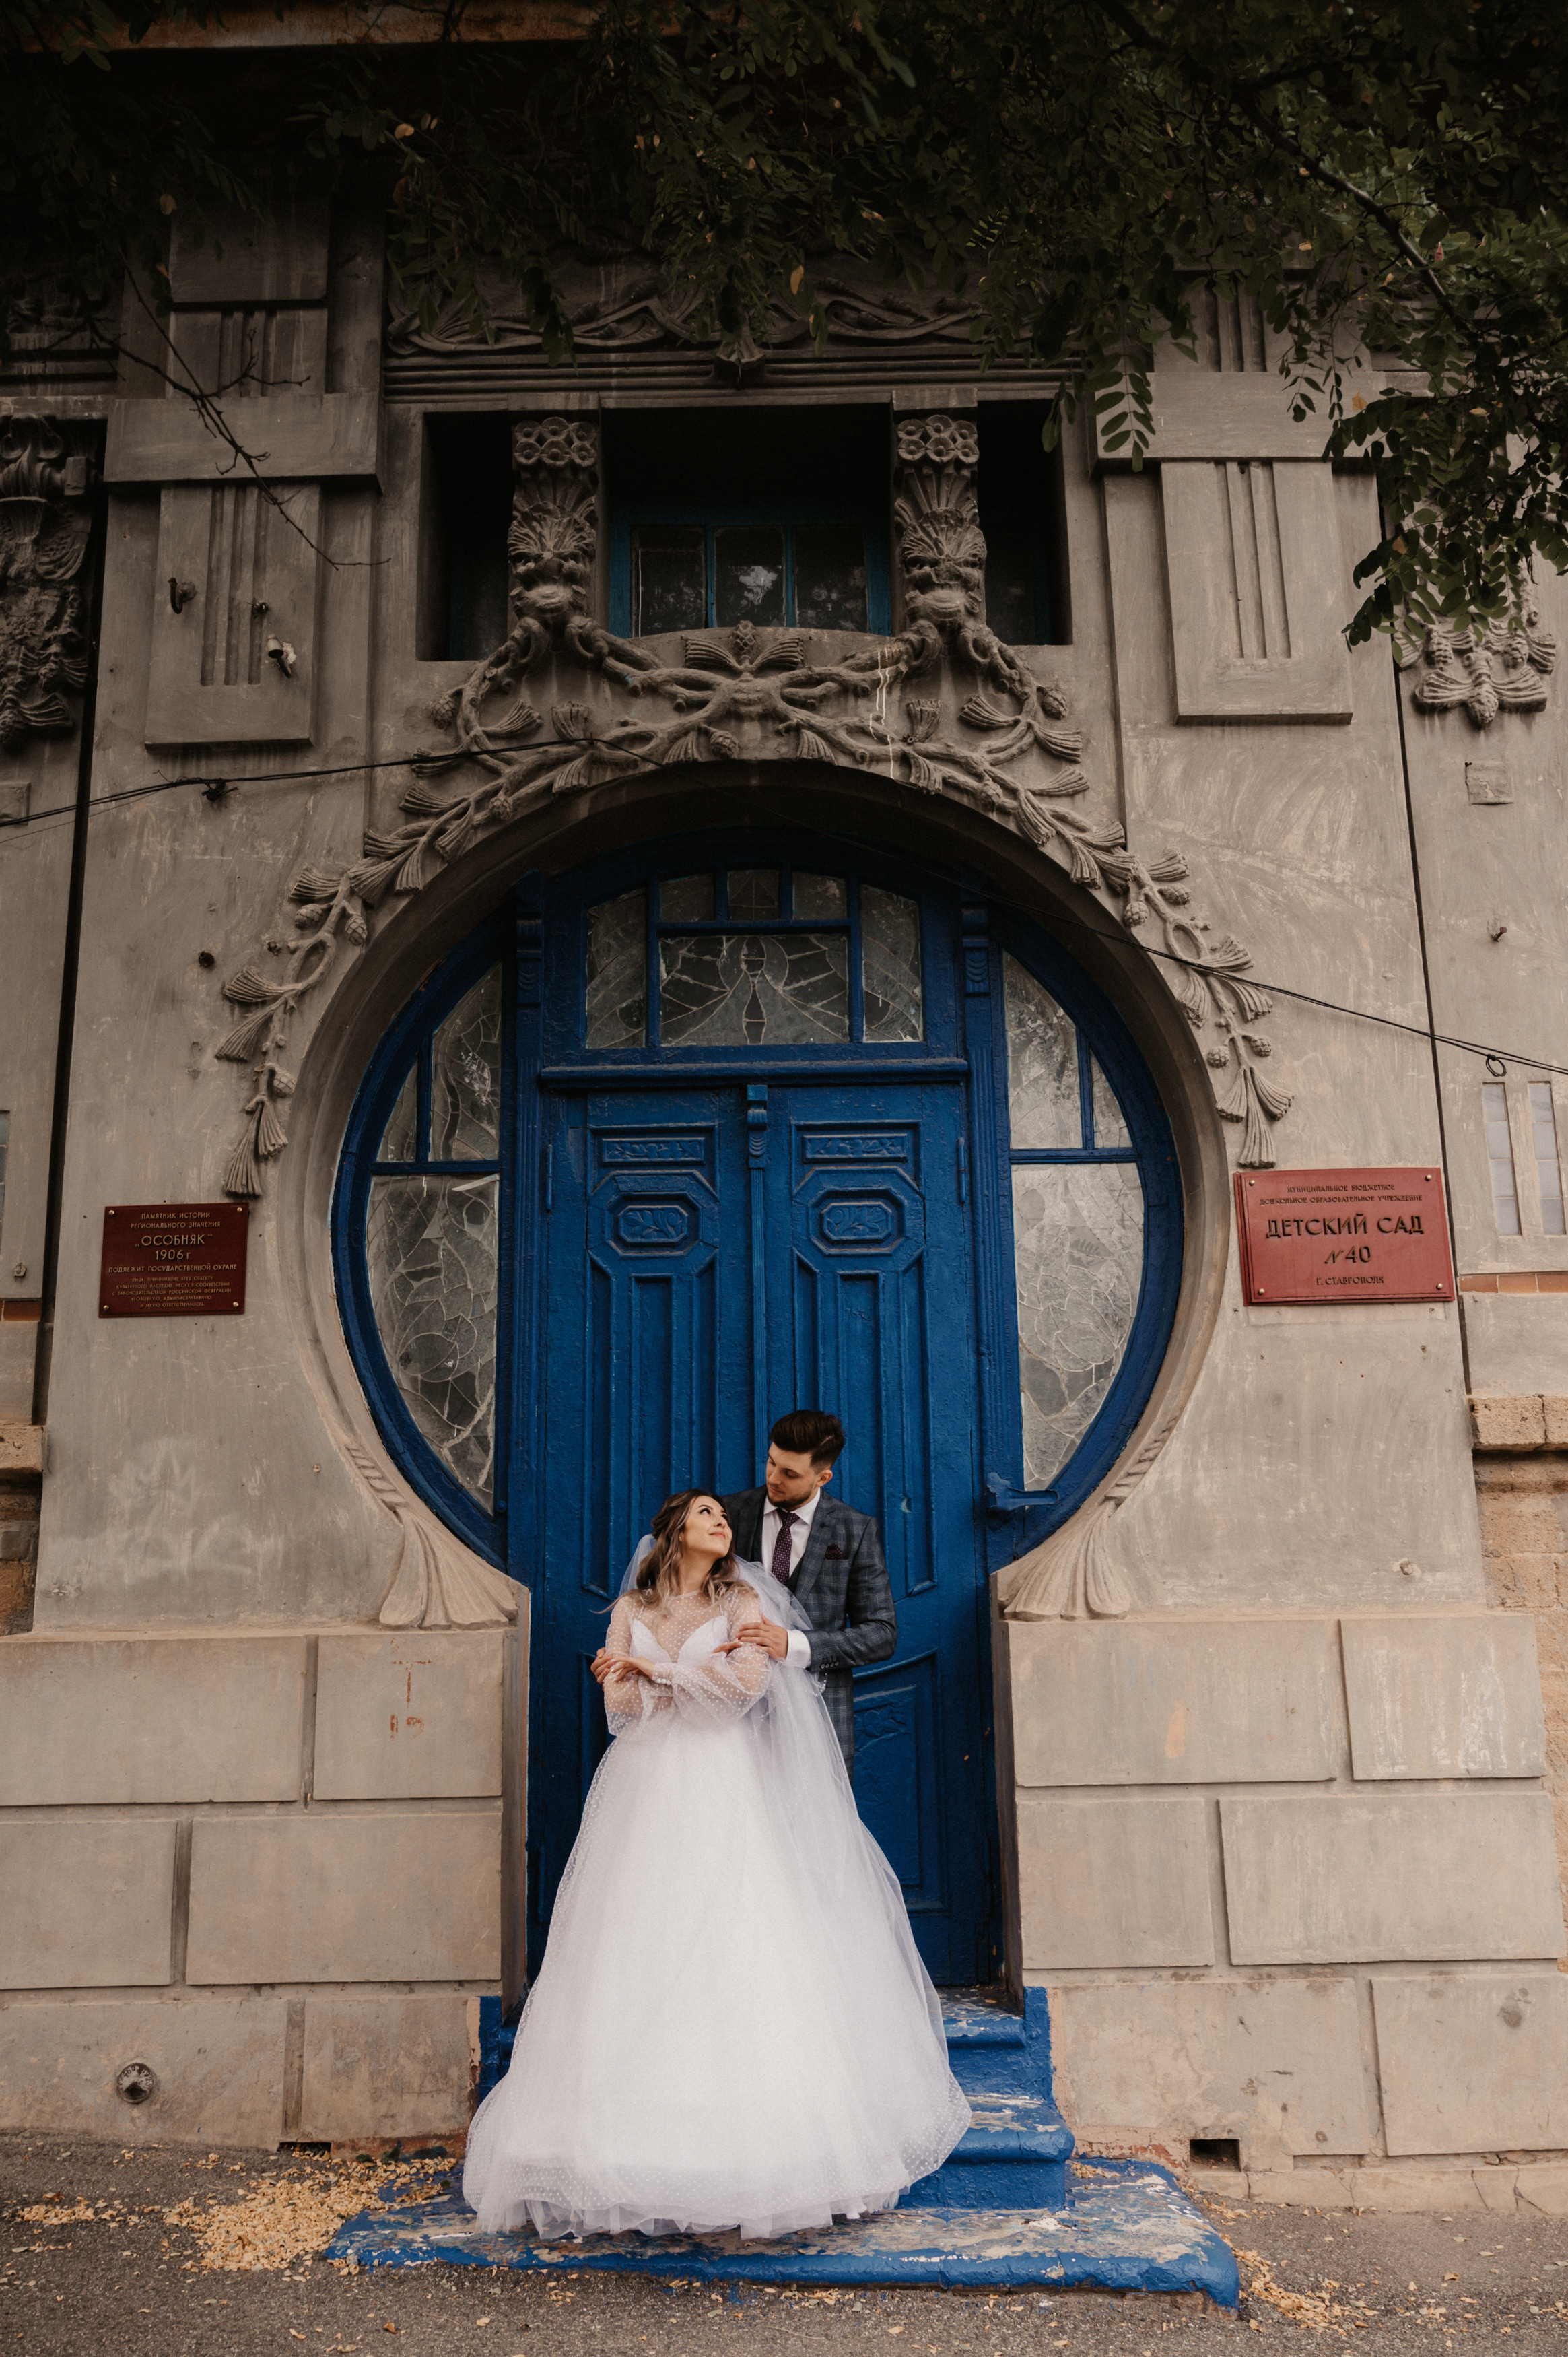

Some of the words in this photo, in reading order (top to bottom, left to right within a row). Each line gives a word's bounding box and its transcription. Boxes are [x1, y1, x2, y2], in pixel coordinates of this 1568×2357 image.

[1287, 1185, 1348, 1193] МУНИЦИПАЛЬНОЕ
[1260, 1197, 1307, 1205] ДОШКОЛЬНОЕ
[1266, 1213, 1368, 1238] ДЕТСКИЙ
[1377, 1215, 1424, 1234] САД
[155, 1250, 183, 1260] 1906
[148, 1263, 211, 1272] ГОСУДАРСТВЕННОЙ
[1325, 1276, 1384, 1286] СТАВРОПОЛЯ
